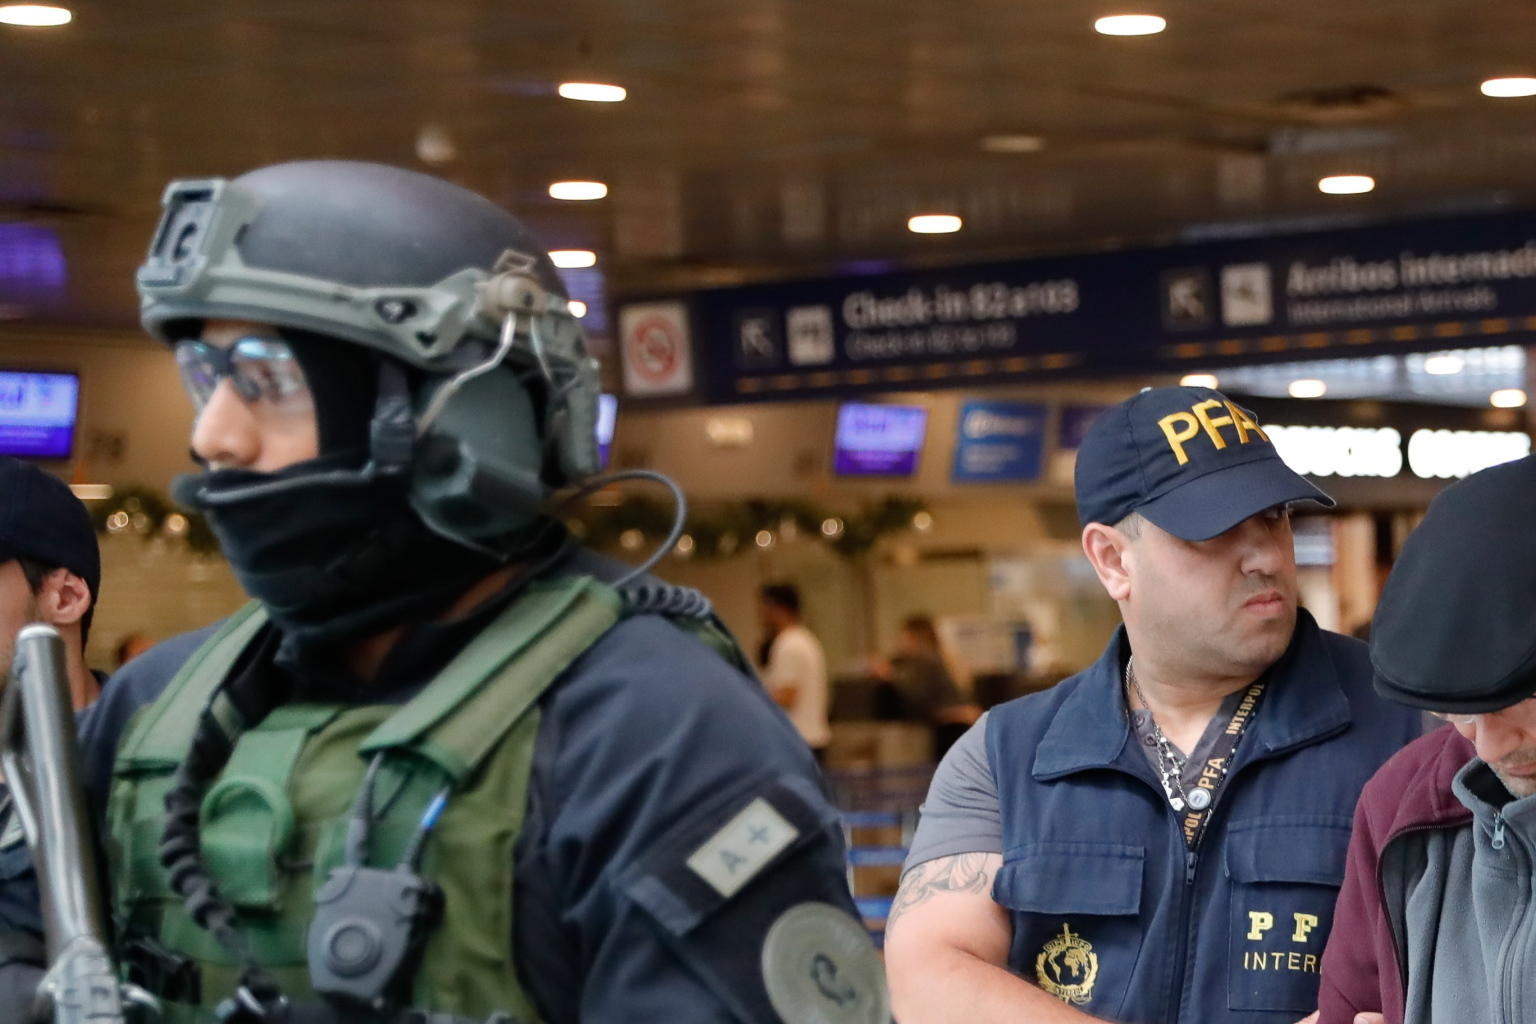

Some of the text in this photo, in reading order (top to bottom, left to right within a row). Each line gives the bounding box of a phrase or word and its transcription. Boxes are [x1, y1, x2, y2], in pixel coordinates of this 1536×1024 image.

[1157, 398, 1270, 466] PFA
[1198, 684, 1265, 790] PFA INTERPOL
[1244, 951, 1322, 975] INTER
